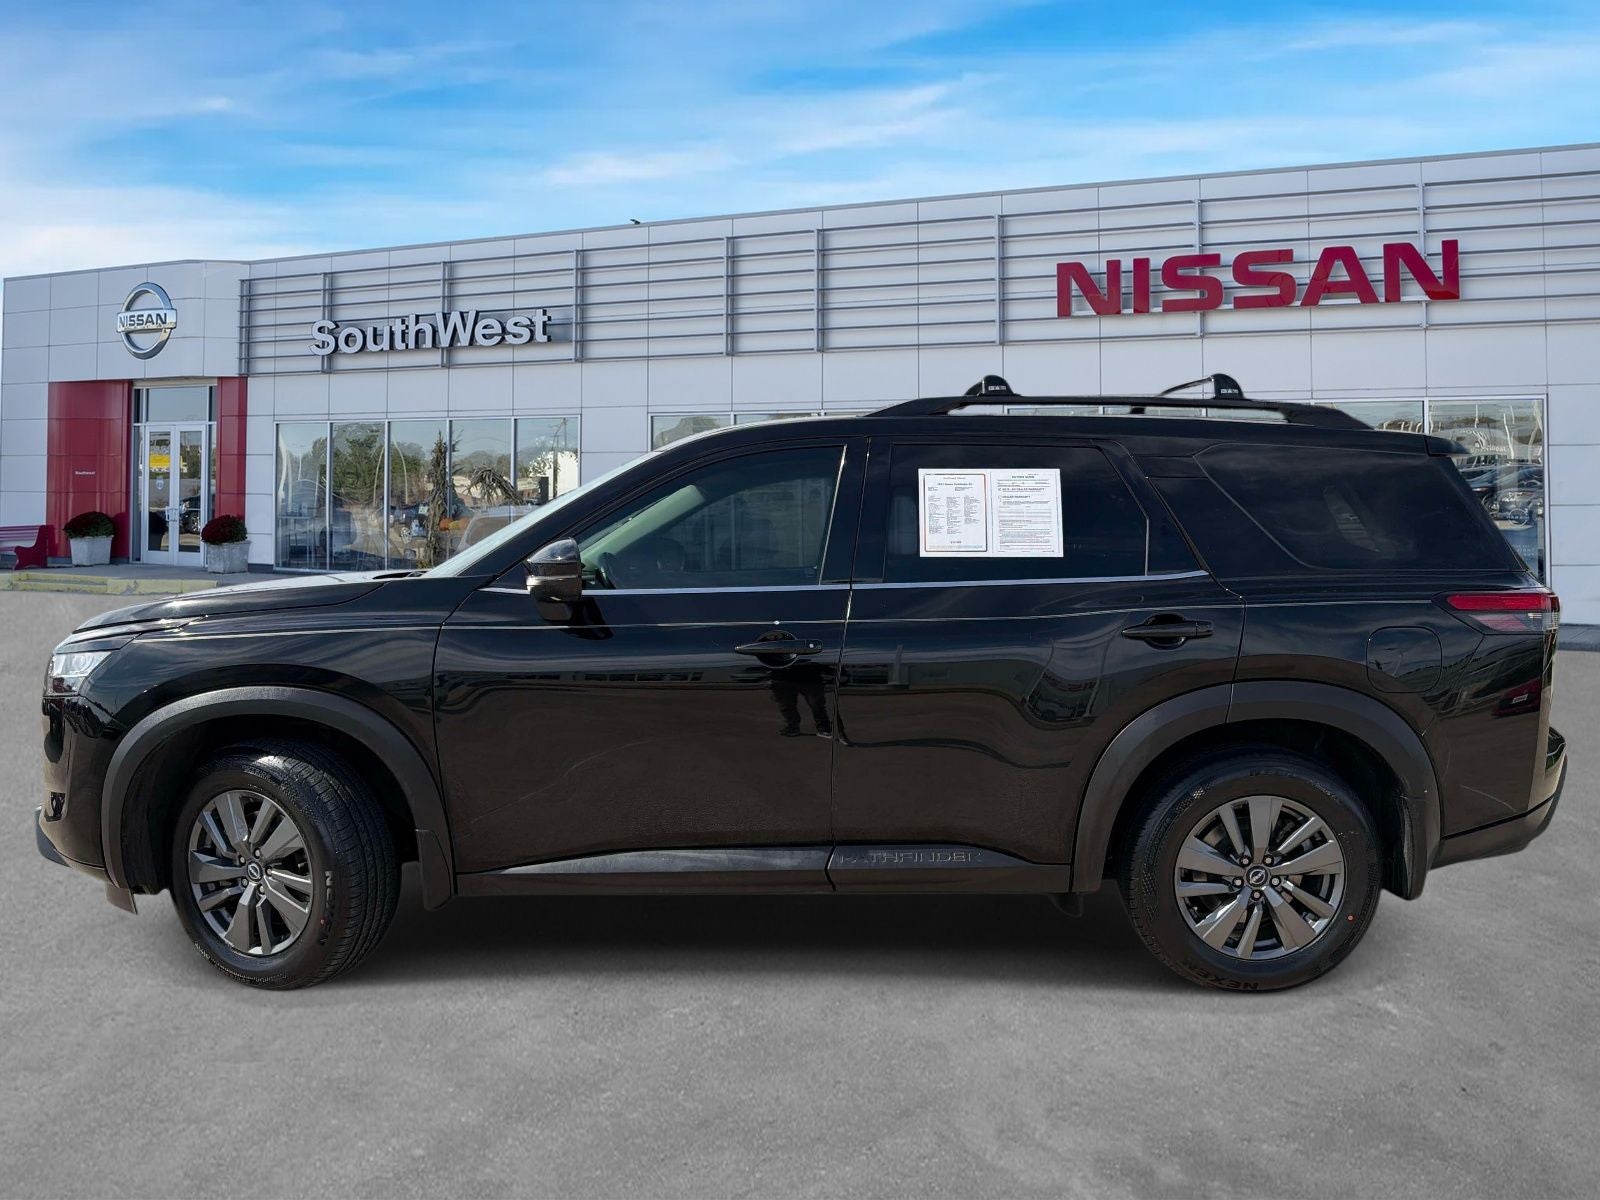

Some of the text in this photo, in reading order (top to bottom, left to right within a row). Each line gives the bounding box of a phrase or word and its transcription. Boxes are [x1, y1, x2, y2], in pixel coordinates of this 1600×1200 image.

[1057, 239, 1460, 317] NISSAN
[118, 312, 167, 328] NISSAN
[308, 308, 551, 356] SouthWest
